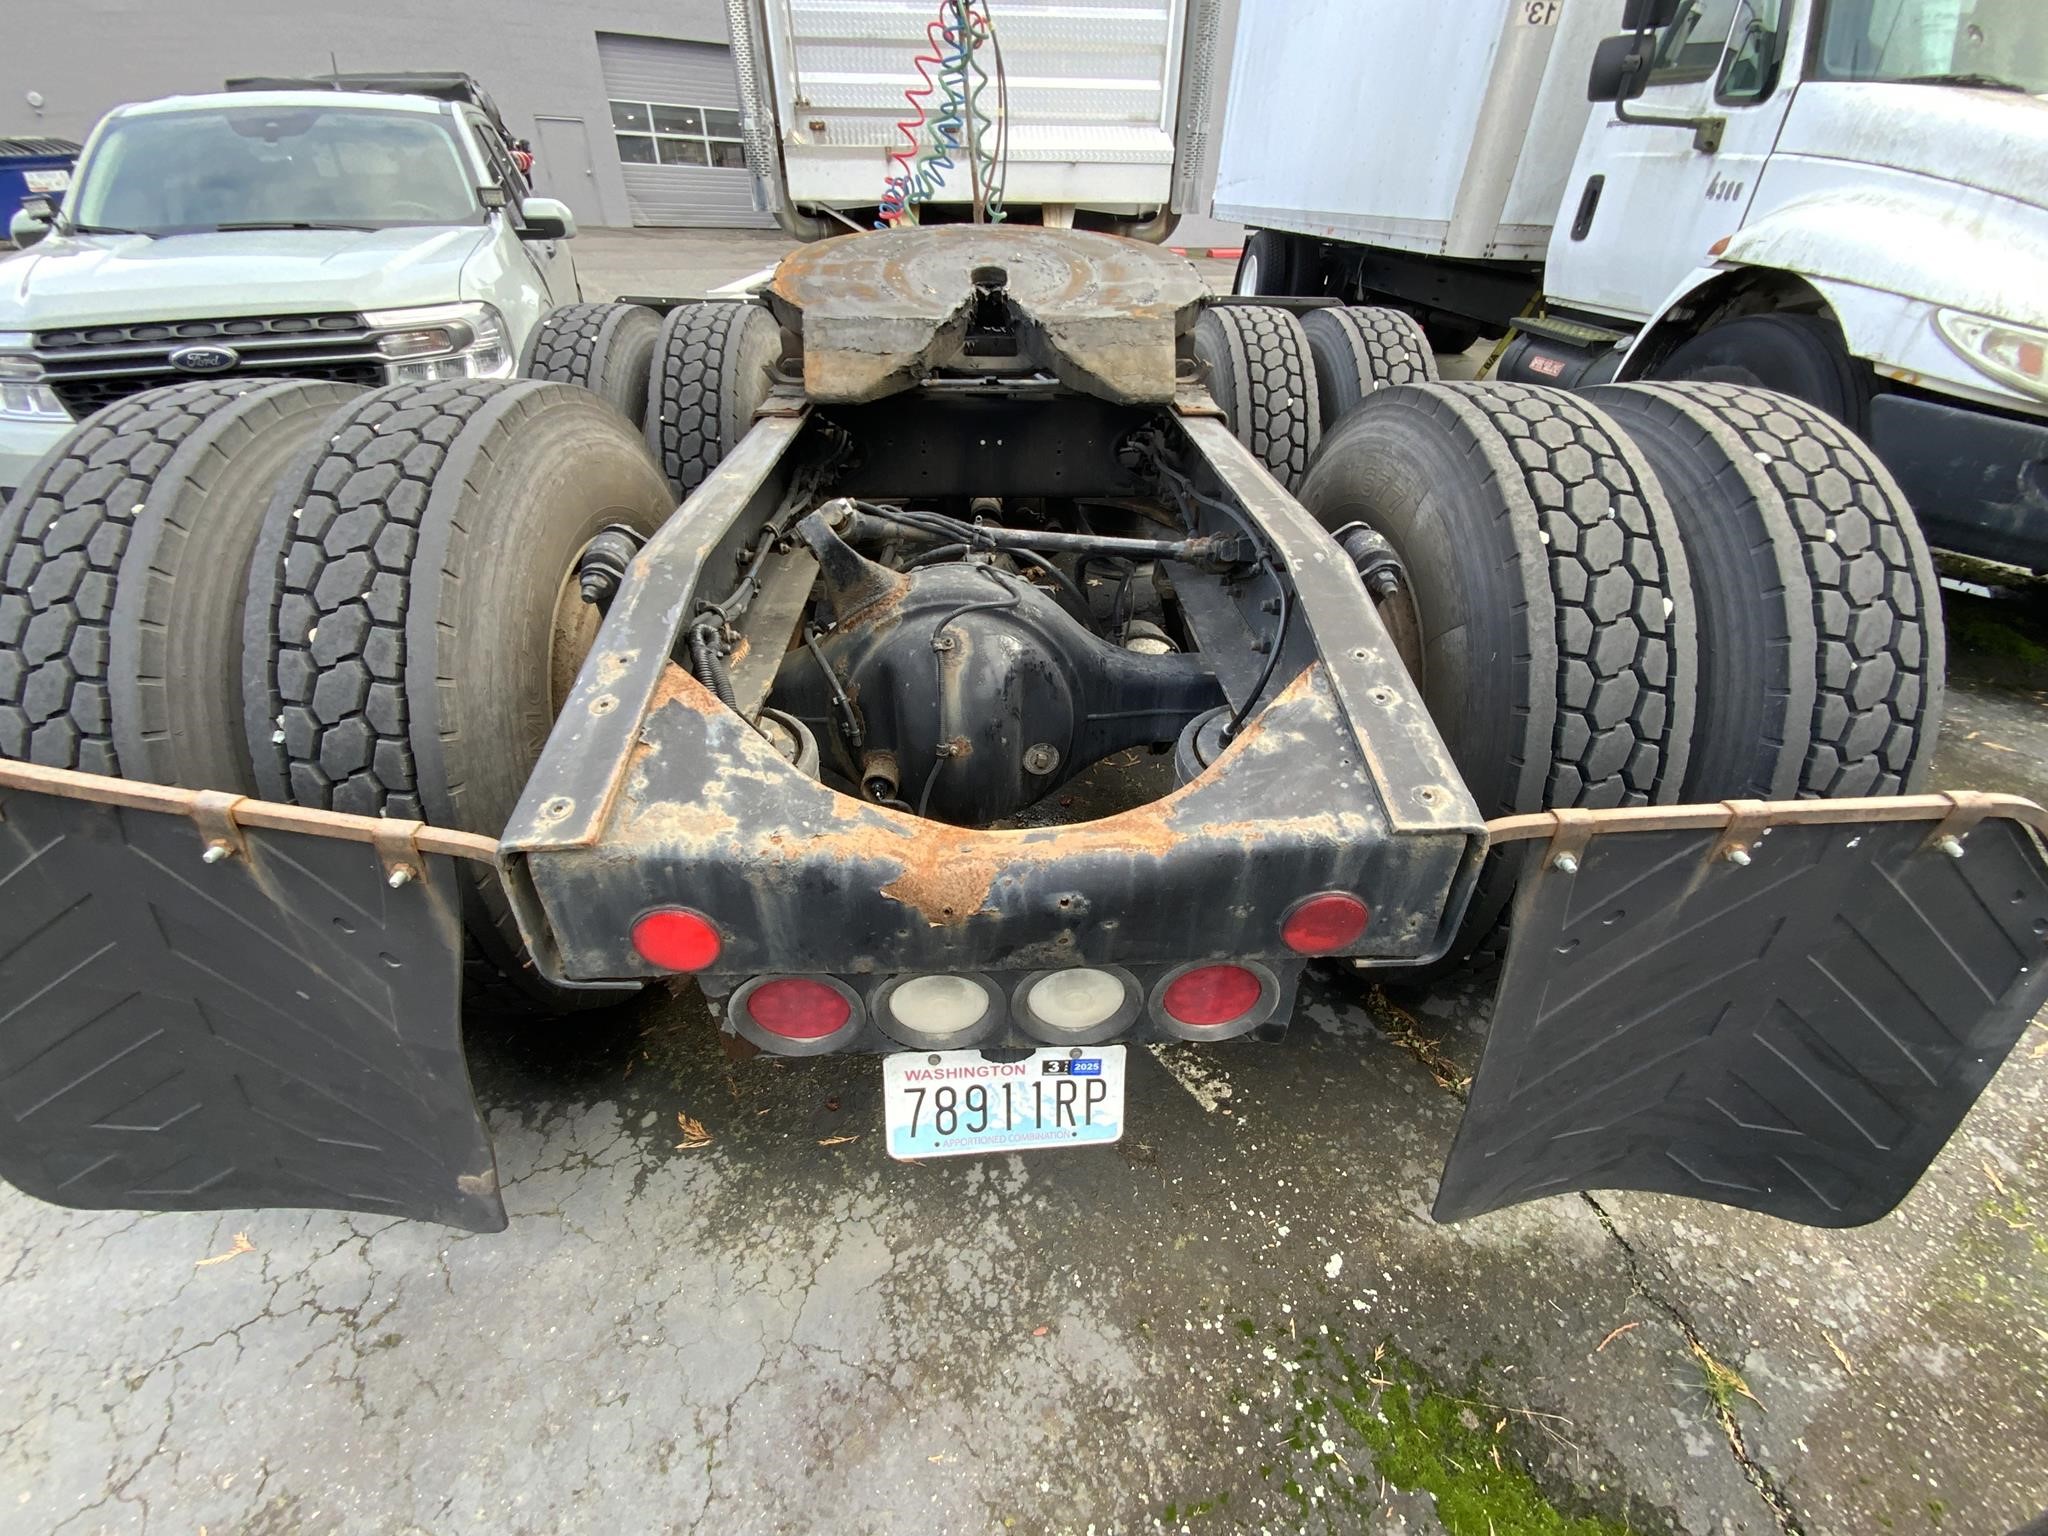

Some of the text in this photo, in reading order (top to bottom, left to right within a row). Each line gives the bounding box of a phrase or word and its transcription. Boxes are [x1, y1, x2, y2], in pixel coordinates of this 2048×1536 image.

[187, 352, 219, 367] Ford
[904, 1064, 1026, 1082] WASHINGTON
[1048, 1061, 1060, 1073] 3
[1074, 1063, 1099, 1071] 2025
[904, 1078, 1107, 1138] 78911RP
[943, 1130, 1071, 1148] APPORTIONED COMBINATION
